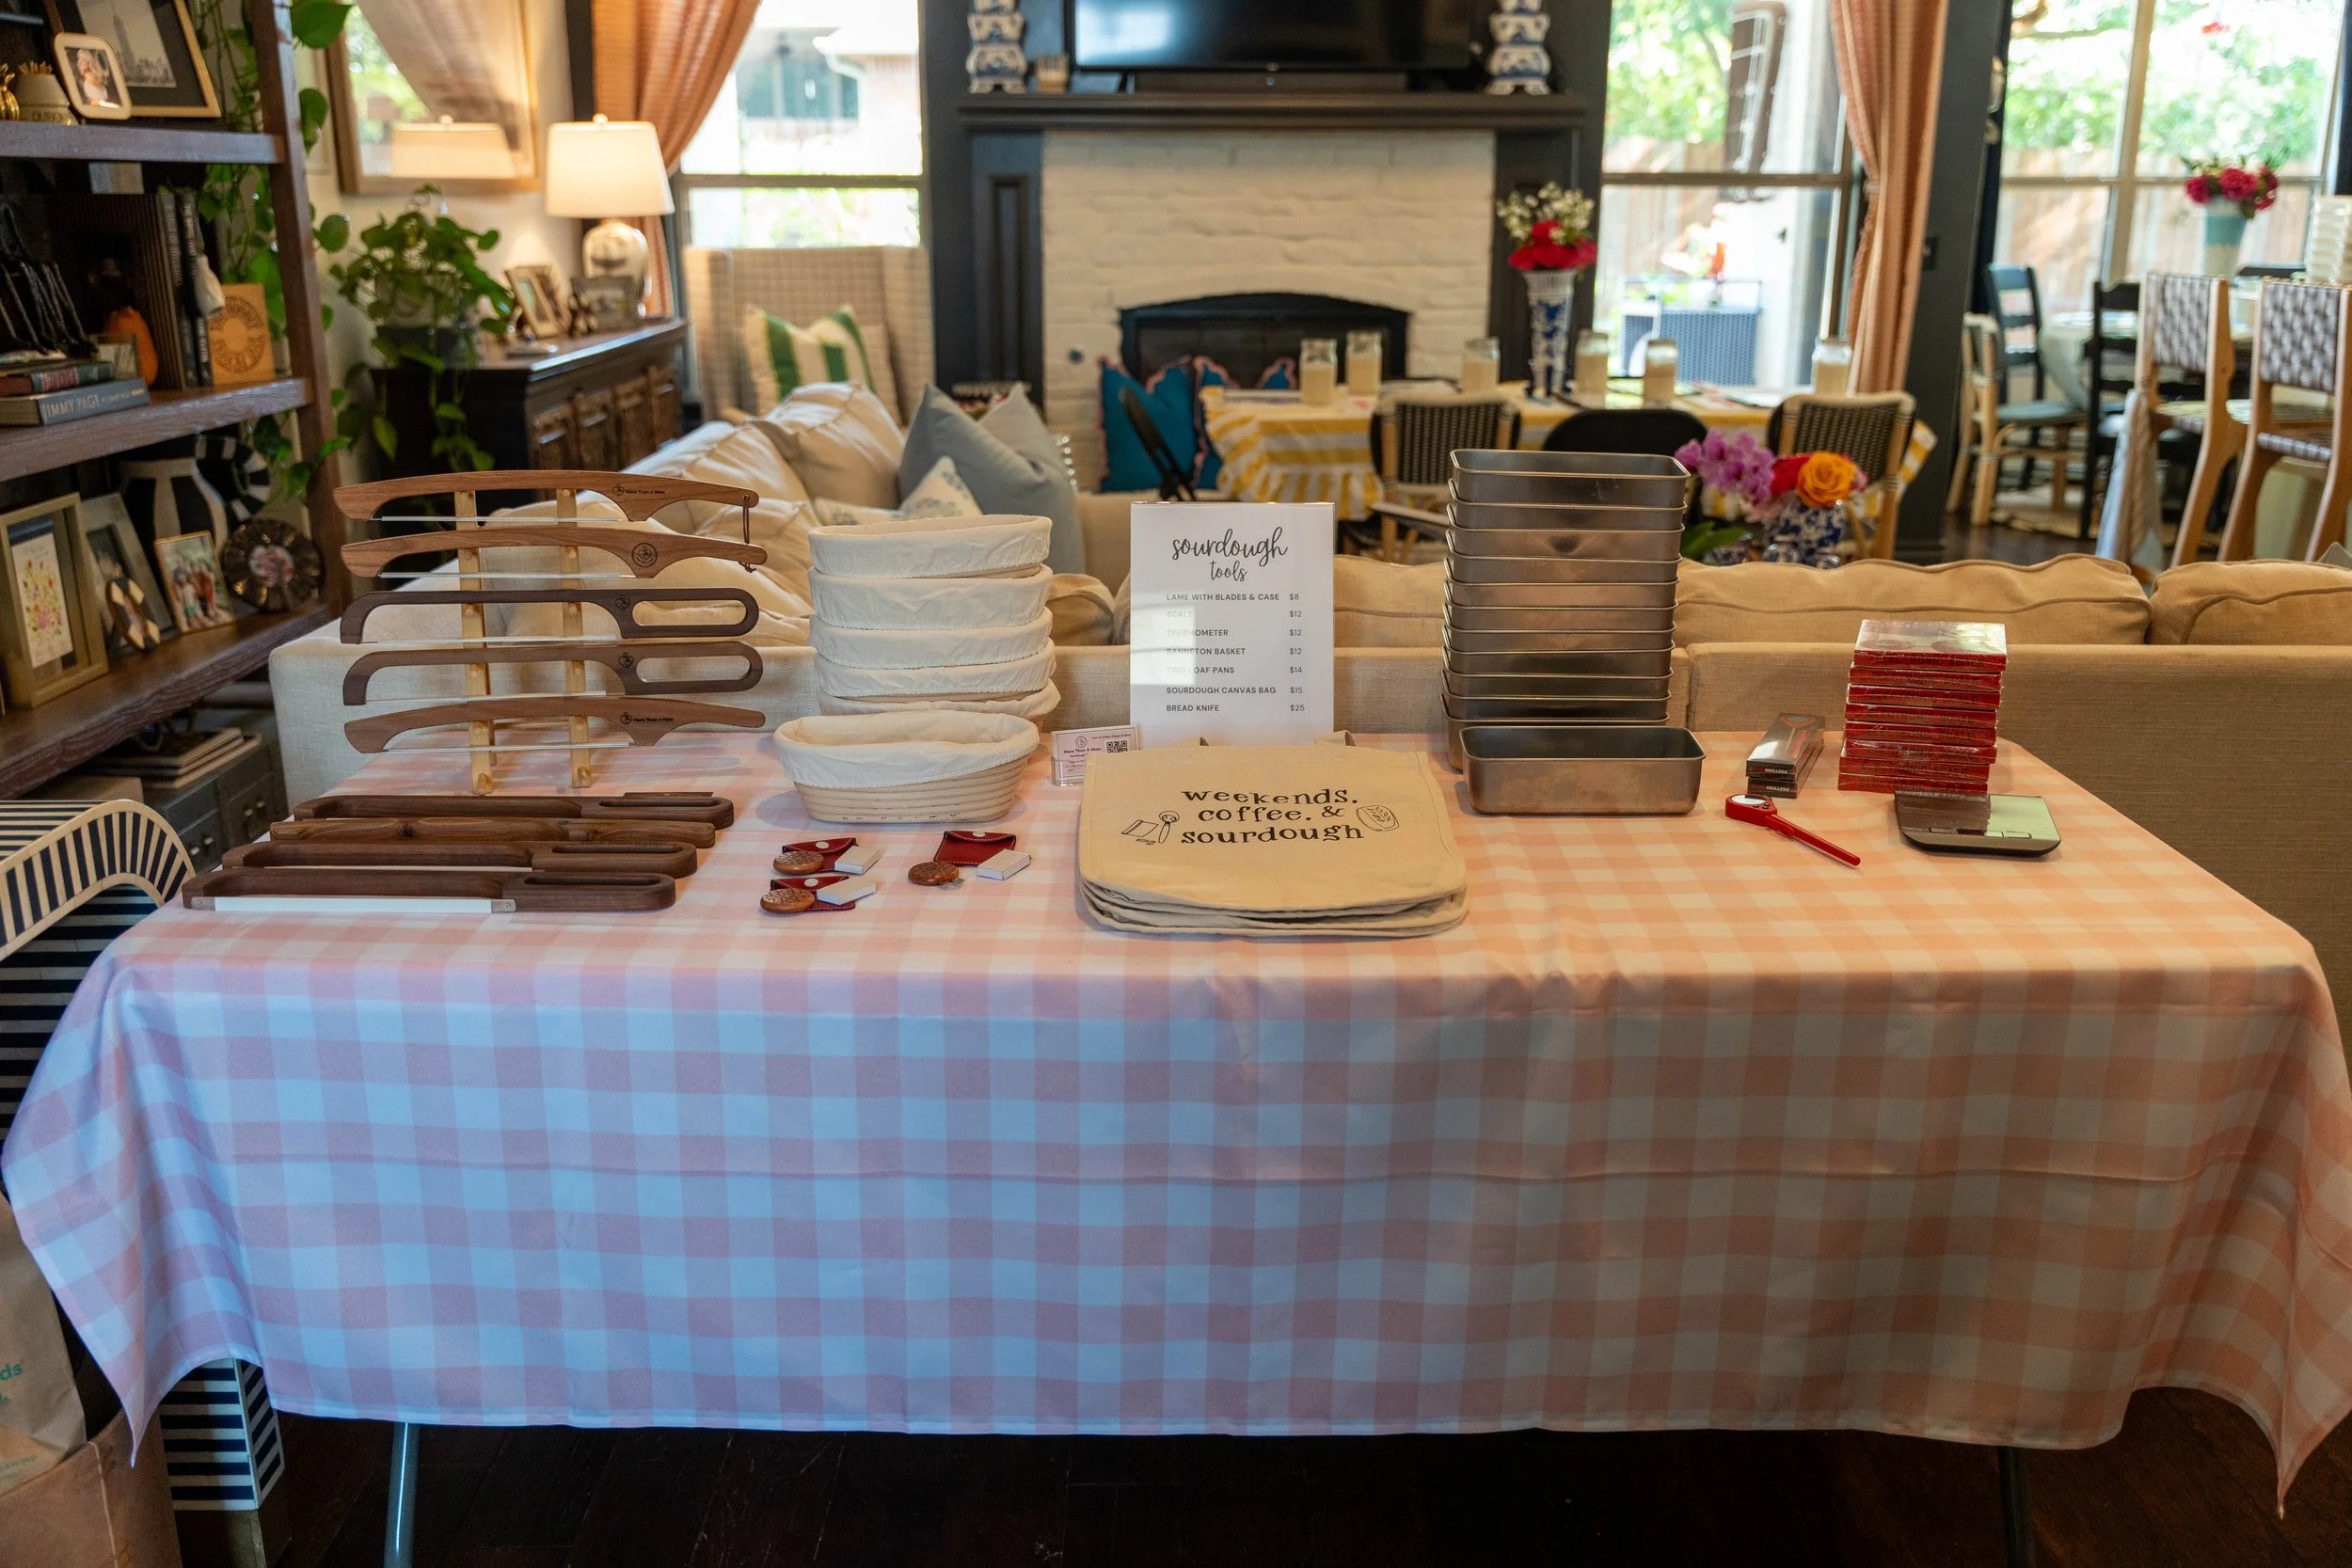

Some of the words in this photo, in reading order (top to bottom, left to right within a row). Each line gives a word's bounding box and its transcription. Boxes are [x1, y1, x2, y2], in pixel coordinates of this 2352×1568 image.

[1171, 526, 1288, 567] sourdough
[1209, 560, 1248, 582] tools
[1289, 593, 1300, 602] $8
[1289, 610, 1302, 618] $12
[1289, 628, 1302, 637] $12
[1166, 647, 1213, 656] BANNETON
[1214, 647, 1246, 656] BASKET
[1289, 647, 1302, 656] $12
[1289, 666, 1303, 674] $14
[1290, 686, 1304, 695] $15
[1290, 704, 1306, 713] $25
[1321, 805, 1345, 818] &
[1181, 824, 1364, 844] sourdough
